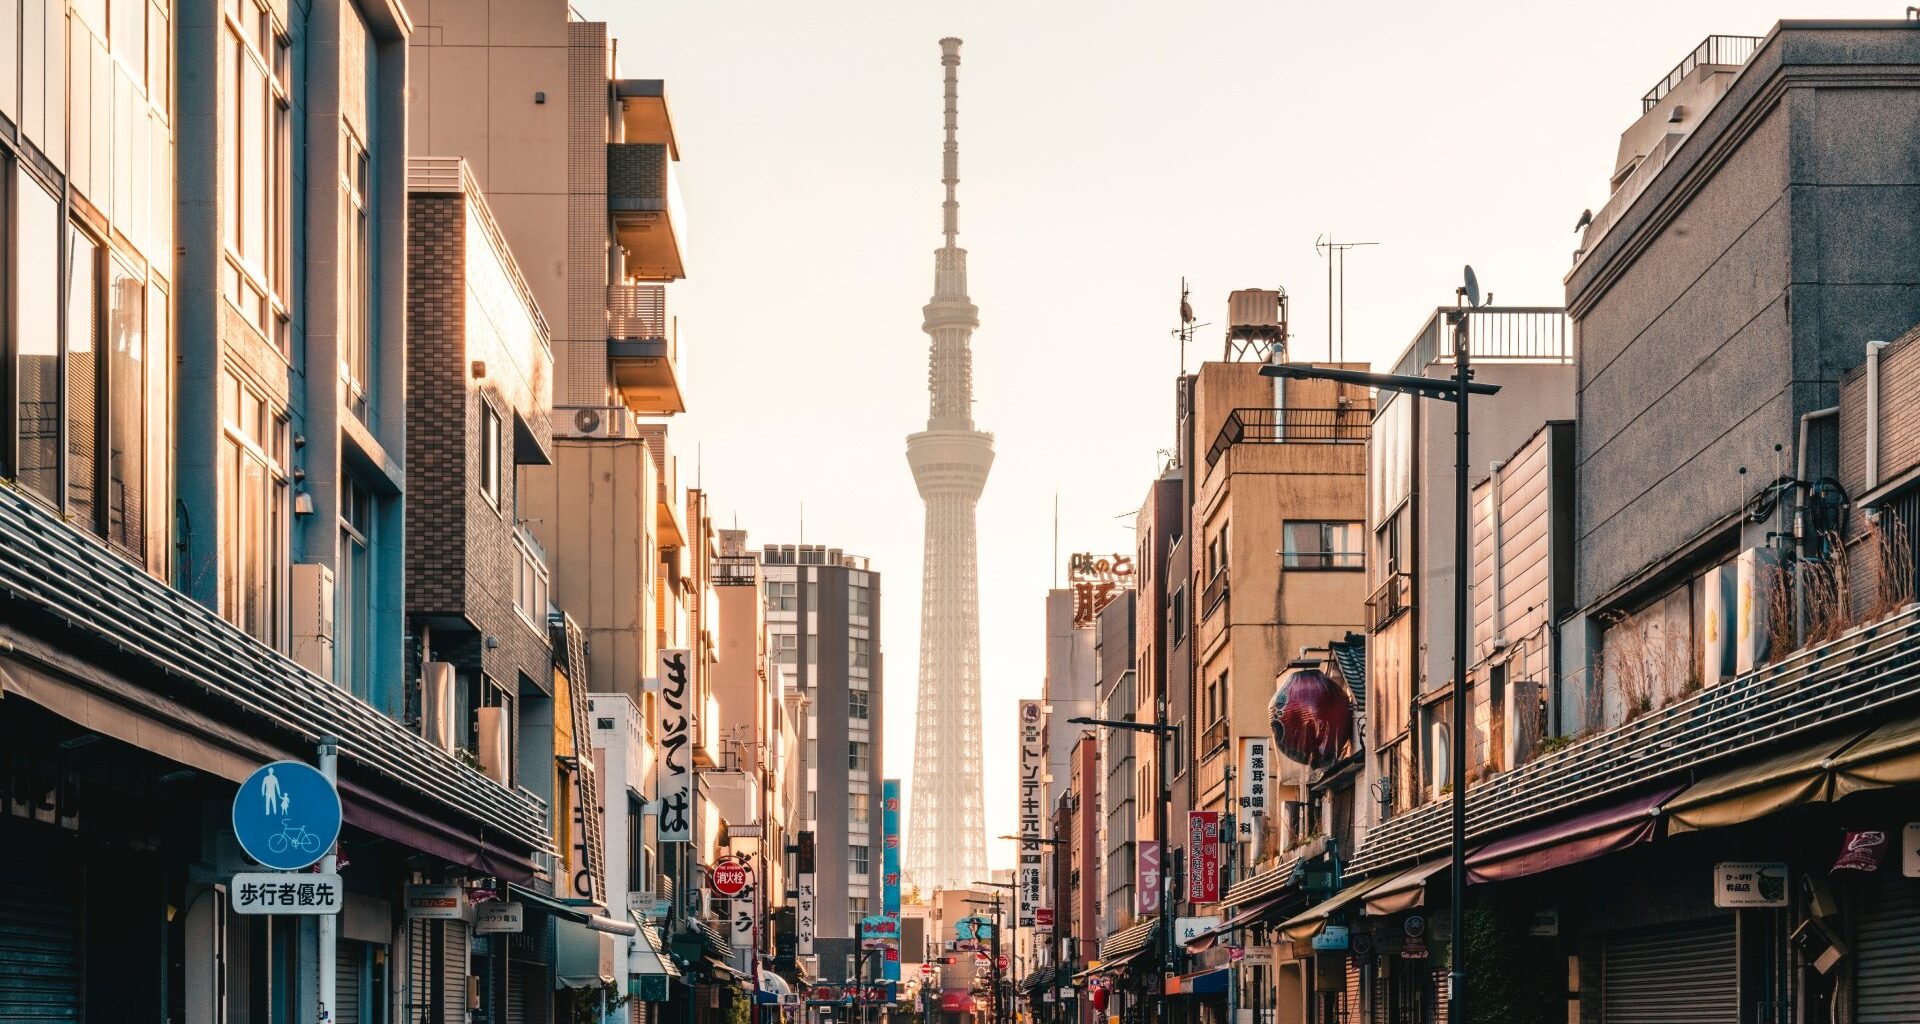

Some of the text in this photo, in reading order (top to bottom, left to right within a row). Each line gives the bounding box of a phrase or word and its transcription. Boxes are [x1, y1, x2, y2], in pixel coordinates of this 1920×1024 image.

[1071, 552, 1136, 576] 味のと
[1022, 744, 1039, 851] トンテキ元気
[1240, 796, 1252, 834] 眼科
[1191, 816, 1204, 898] 韓国家庭料理
[240, 883, 334, 906] 歩行者優先
[716, 871, 744, 884] 消火栓
[1141, 846, 1160, 910] くすり
